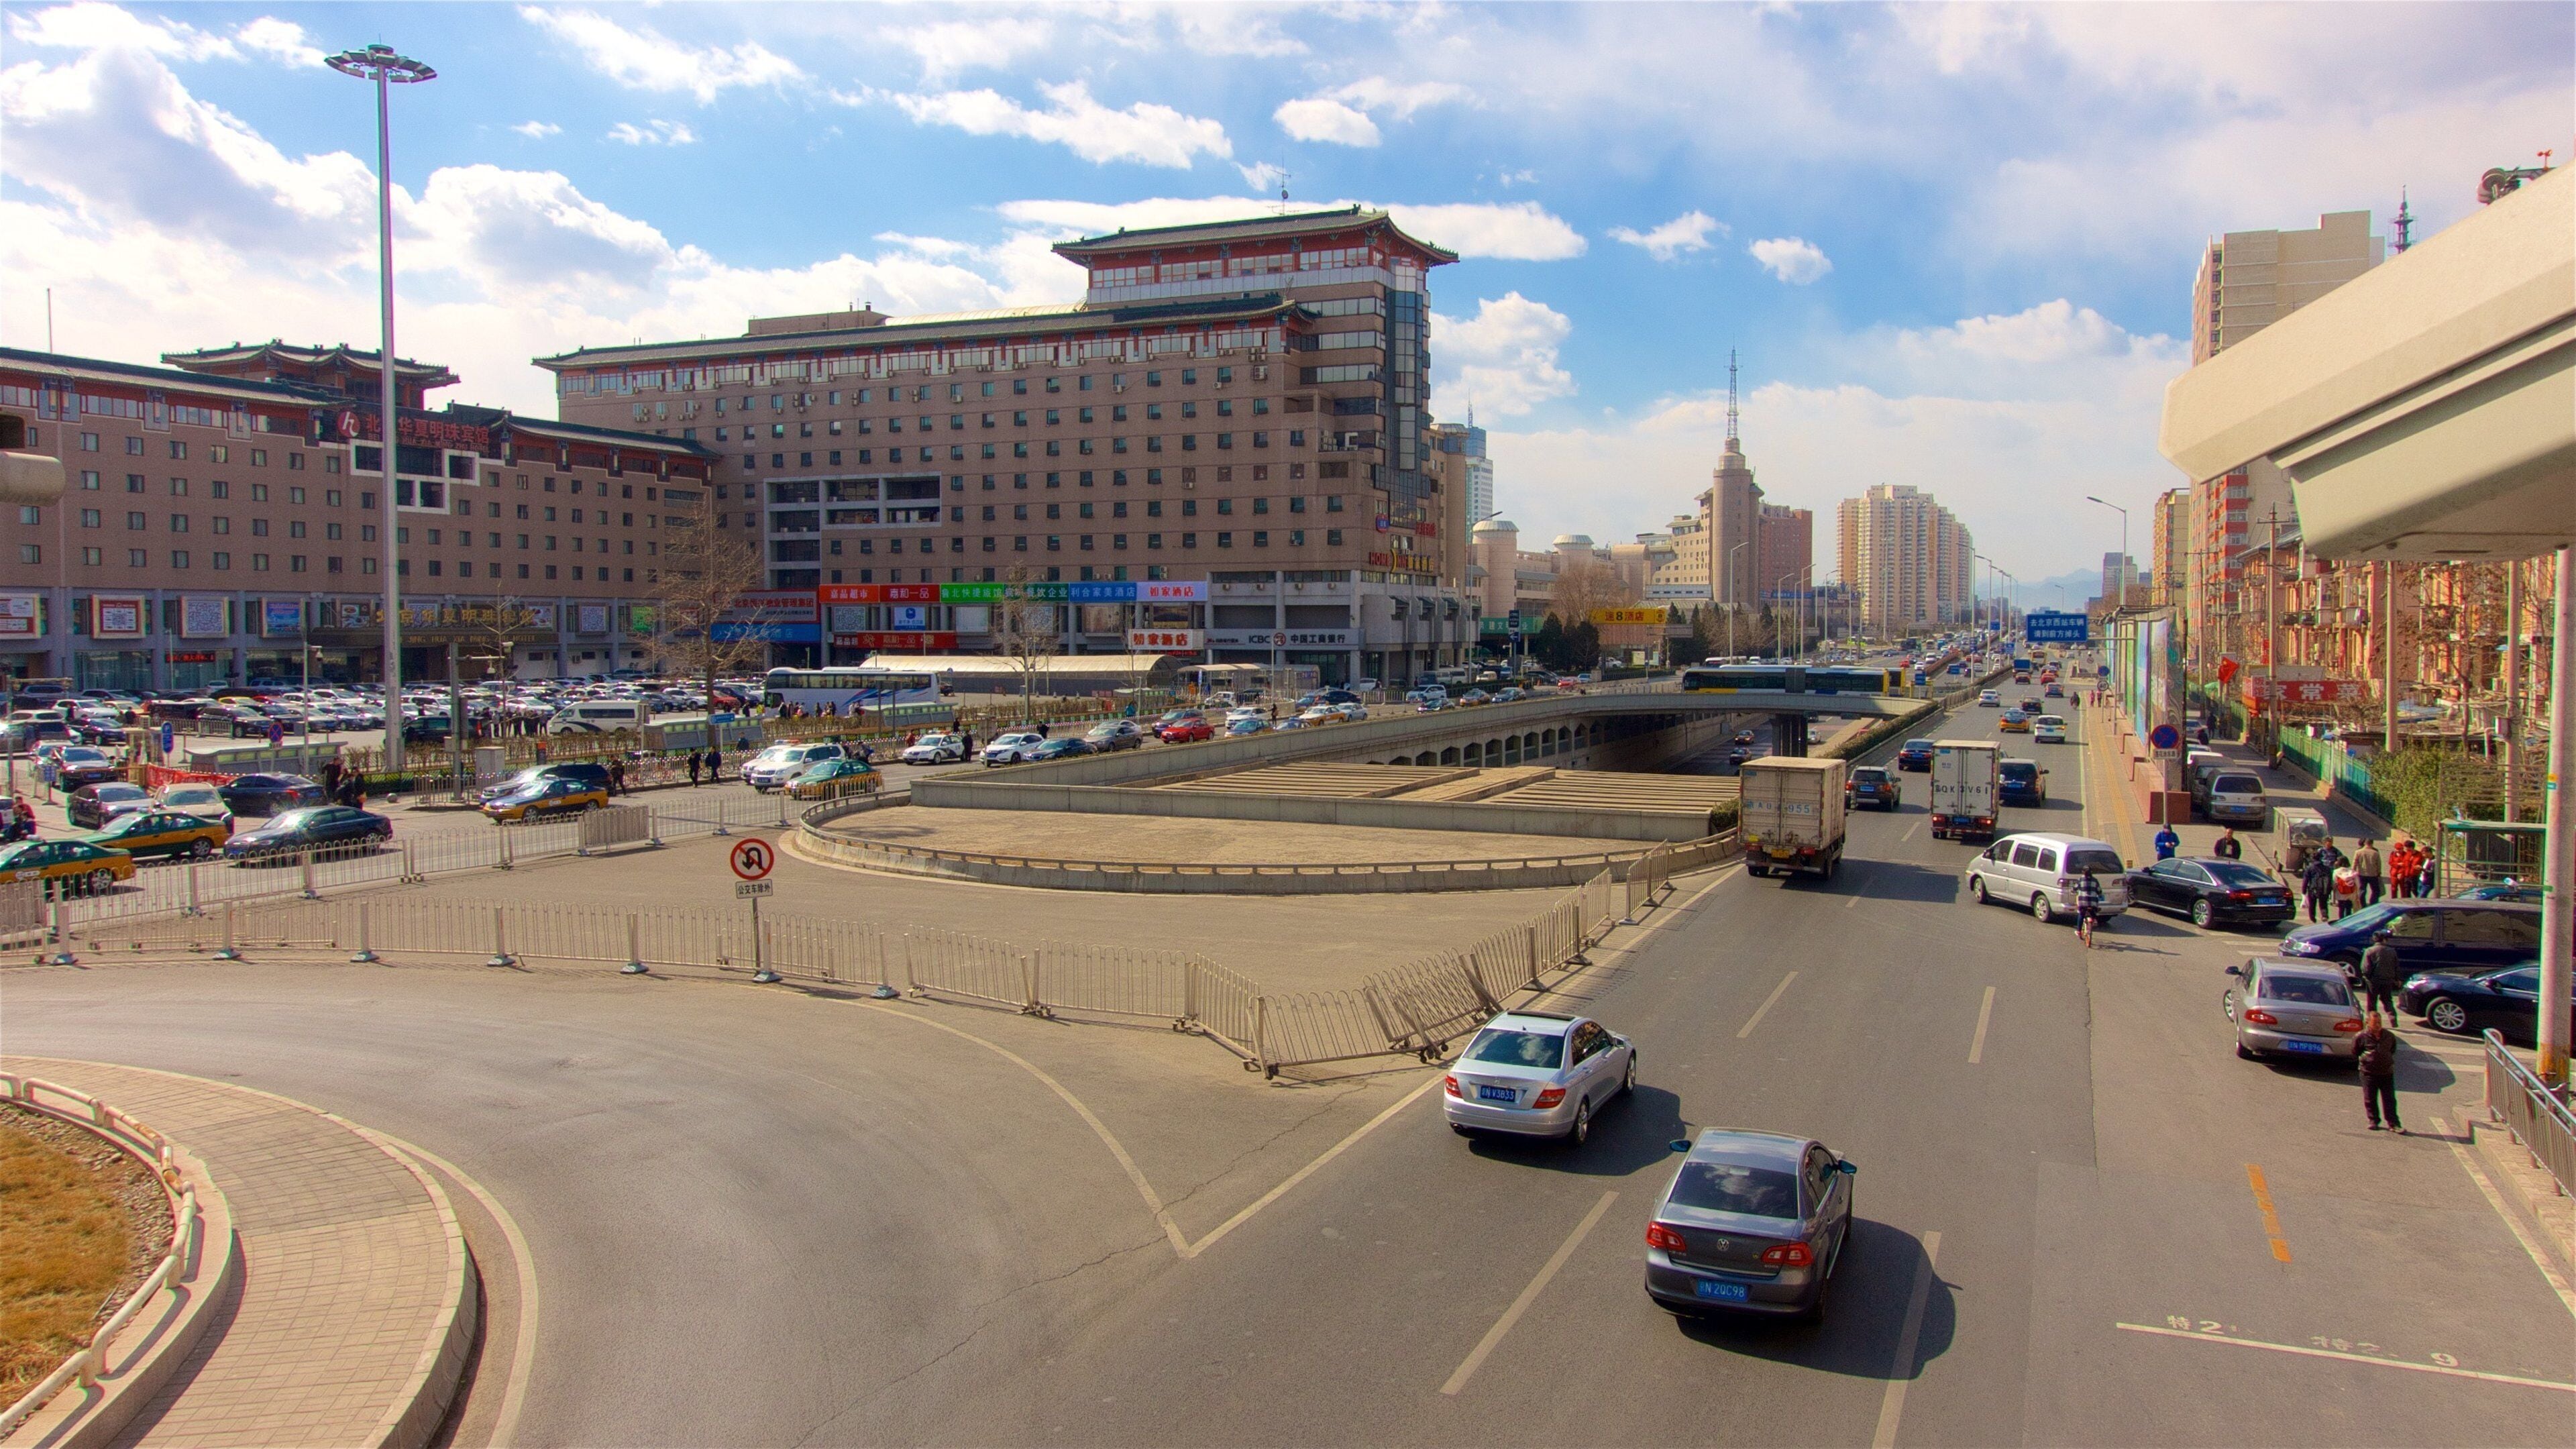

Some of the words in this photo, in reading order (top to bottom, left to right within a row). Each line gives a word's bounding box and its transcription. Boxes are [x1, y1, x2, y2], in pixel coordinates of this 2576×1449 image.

[366, 414, 489, 444] 北华夏明珠宾馆
[890, 588, 929, 599] 嘉和一品
[942, 588, 1002, 598] 鲁北快捷旅馆
[1071, 586, 1136, 597] 利合家美酒店
[1150, 586, 1194, 597] 如家酒店
[1605, 611, 1644, 622] 速8酒店
[2030, 618, 2084, 627] 去北京西站车辆
[1248, 635, 1271, 643] ICBC
[1291, 634, 1346, 643] 中国工商银行
[2034, 629, 2080, 638] 请到前方掉头
[1133, 633, 1188, 646] 如家酒店
[739, 883, 771, 895] 公交车除外
